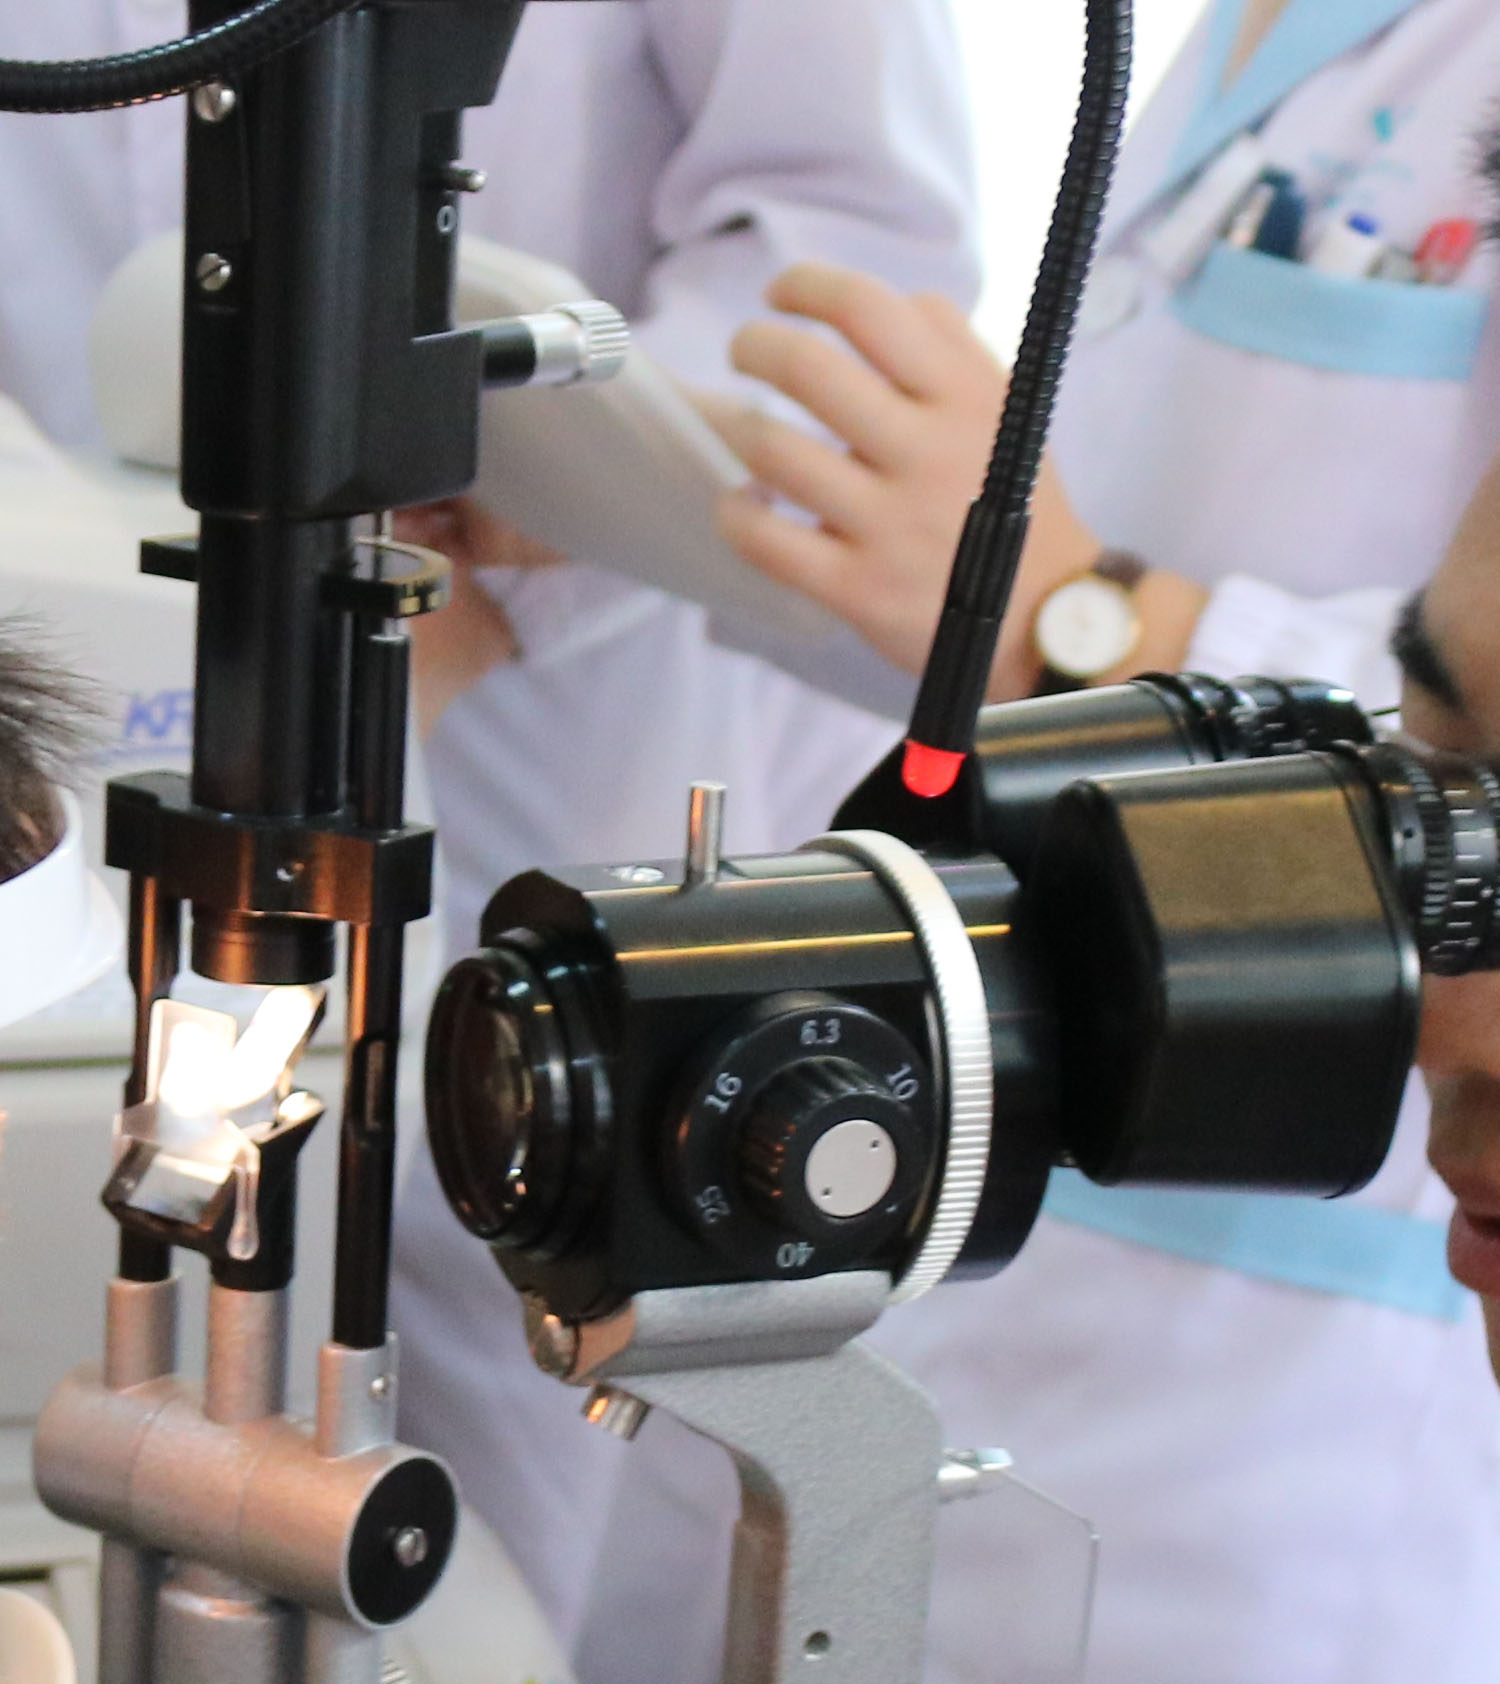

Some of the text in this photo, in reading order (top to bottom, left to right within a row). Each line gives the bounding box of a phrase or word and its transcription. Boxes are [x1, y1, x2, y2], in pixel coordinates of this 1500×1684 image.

[800, 1018, 841, 1044] 6.3
[704, 1072, 742, 1113] 16
[887, 1063, 919, 1101] 10
[695, 1185, 731, 1224] 25
[776, 1242, 815, 1268] 40
